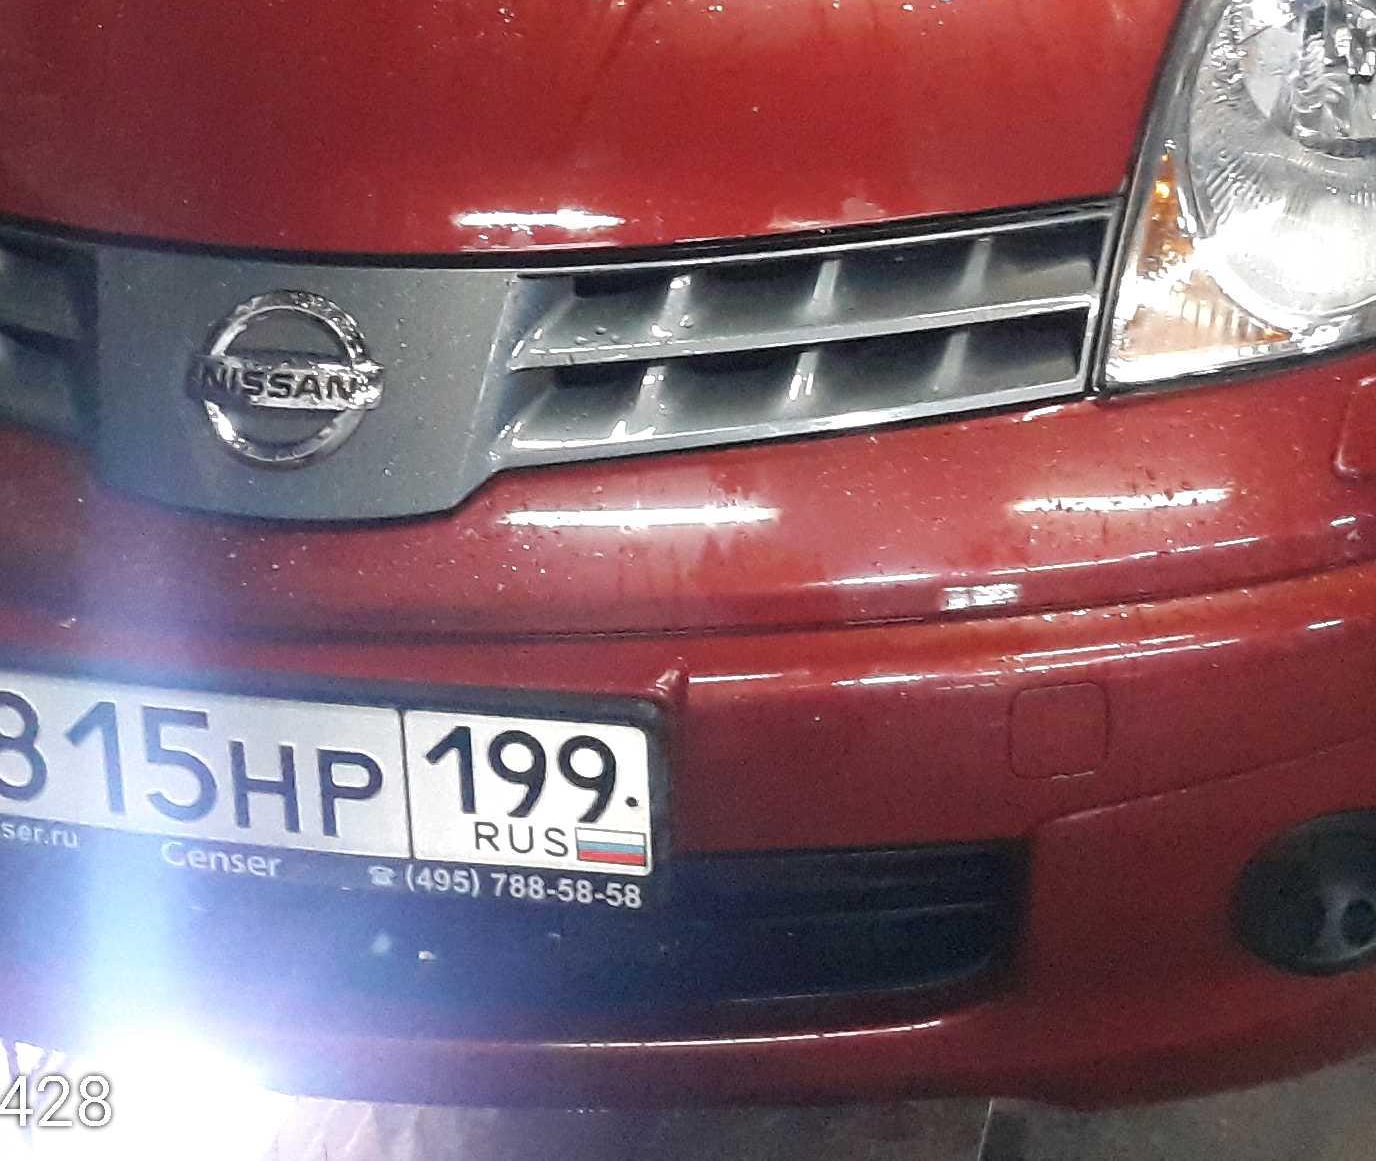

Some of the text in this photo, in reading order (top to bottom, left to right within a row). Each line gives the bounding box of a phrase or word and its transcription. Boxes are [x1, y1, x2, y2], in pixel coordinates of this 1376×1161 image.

[199, 366, 358, 401] NISSAN
[425, 725, 617, 824] 199
[474, 821, 569, 857] RUS
[405, 865, 642, 909] (495) 788-58-58
